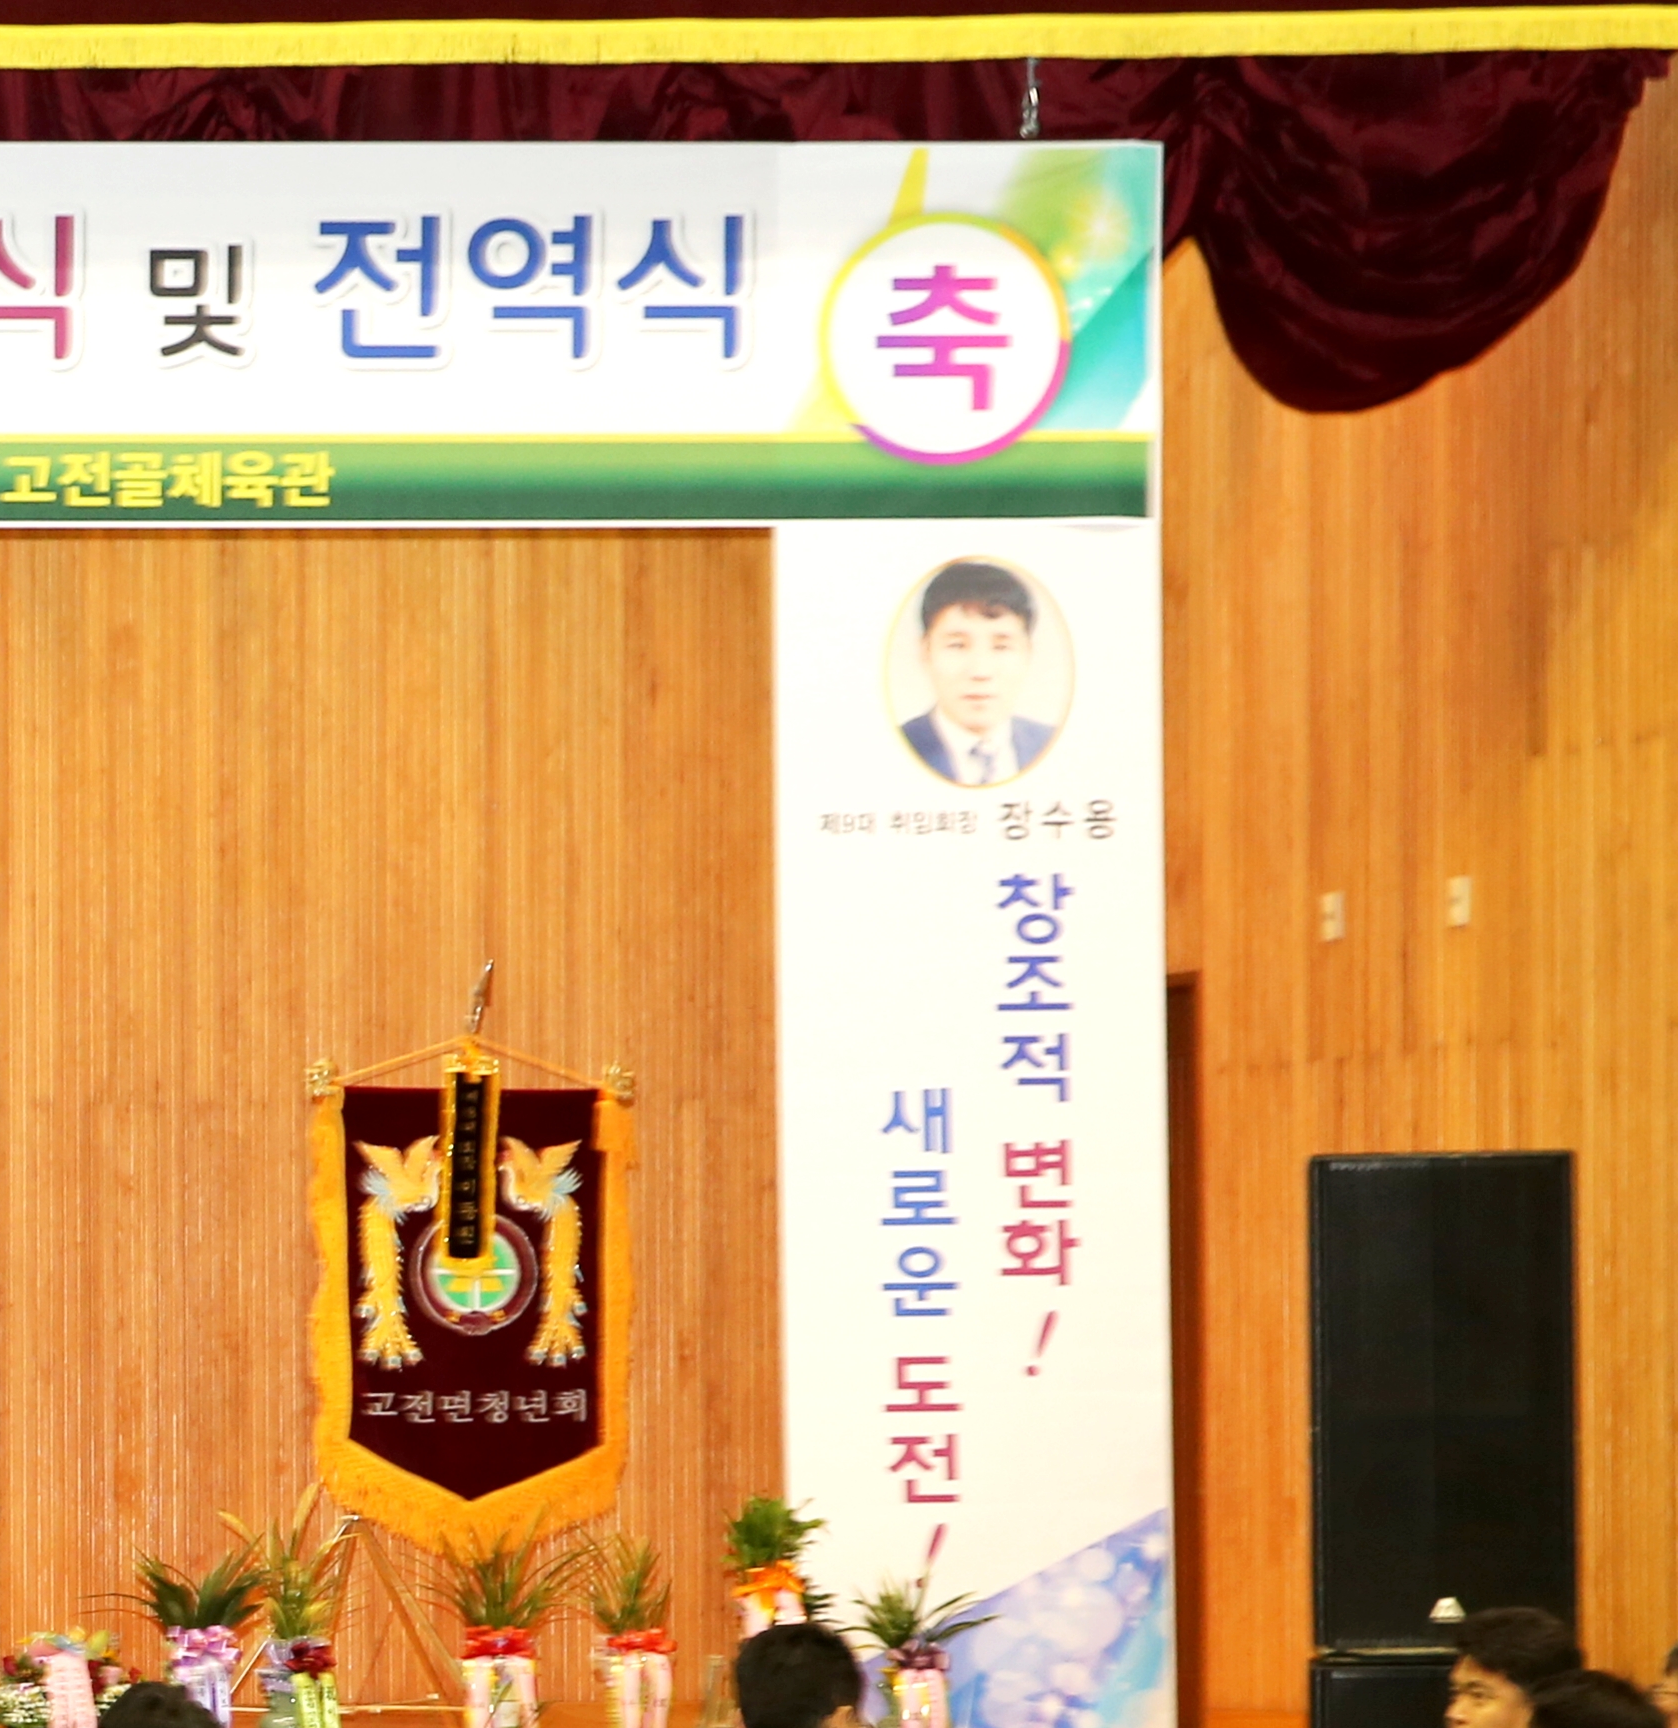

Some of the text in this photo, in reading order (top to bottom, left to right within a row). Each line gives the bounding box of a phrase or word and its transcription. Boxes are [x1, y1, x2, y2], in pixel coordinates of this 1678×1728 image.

[149, 244, 243, 357] 및
[314, 214, 744, 359] 전역식
[874, 264, 1011, 412] 축
[998, 799, 1117, 841] 장수용
[997, 873, 1073, 1103] 창조적
[881, 1088, 957, 1317] 새로운
[362, 1388, 587, 1423] 고전면청년회
